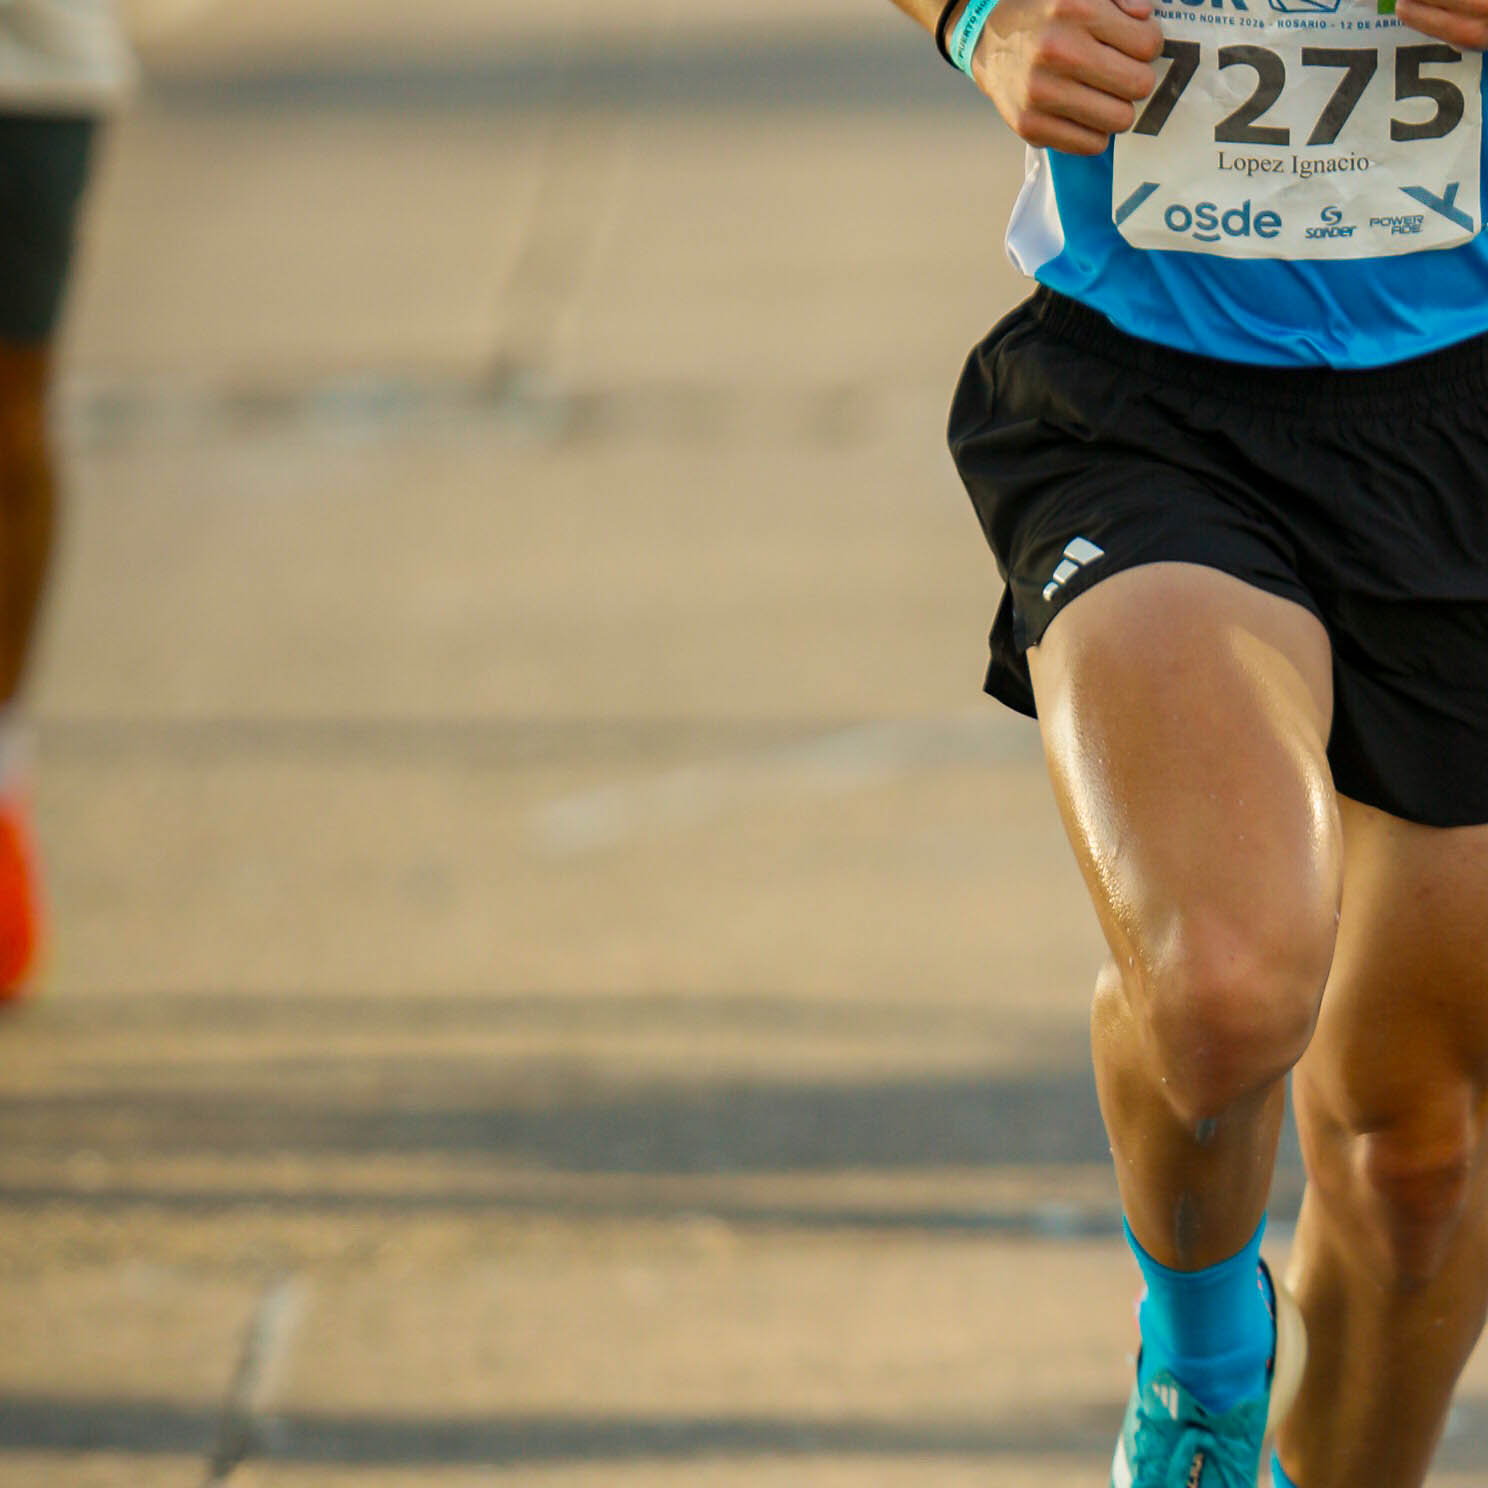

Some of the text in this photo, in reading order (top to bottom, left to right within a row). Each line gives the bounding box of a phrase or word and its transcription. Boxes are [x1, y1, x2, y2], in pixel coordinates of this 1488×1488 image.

[1154, 8, 1196, 21] PUERTO
[1199, 13, 1235, 25] NORTE
[1277, 19, 1327, 29] ROSARIO
[1340, 20, 1352, 30] 12
[1357, 20, 1371, 30] DE
[1132, 39, 1465, 146] 7275
[1217, 151, 1370, 179] Lopez Ignacio
[1164, 199, 1283, 240] osde
[1370, 214, 1425, 229] POWER
